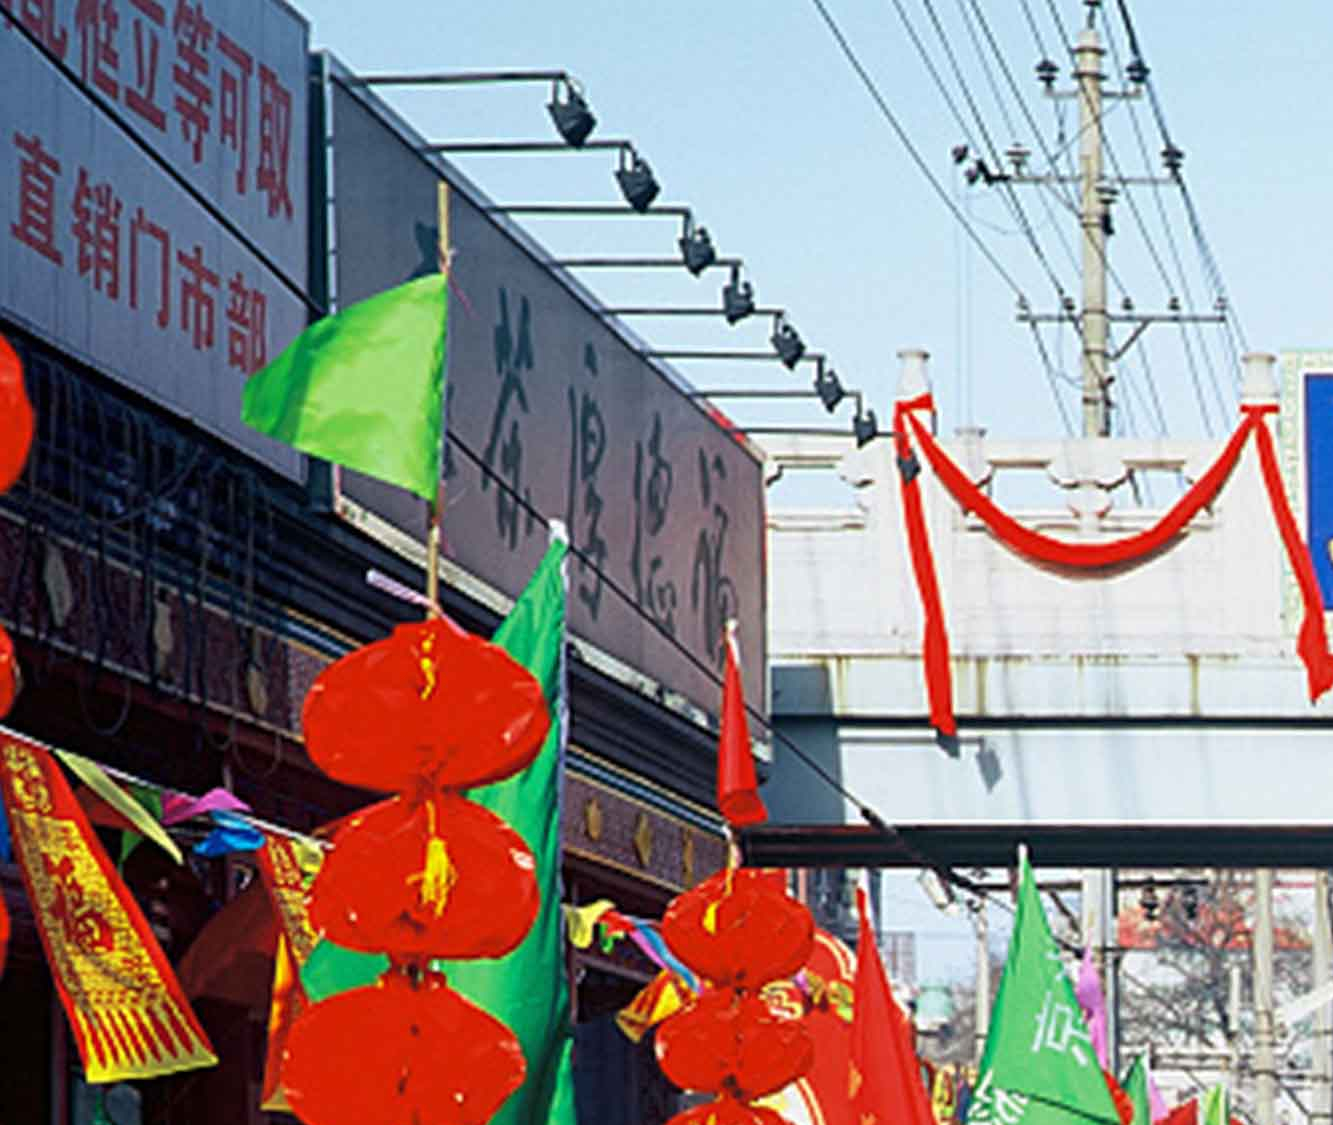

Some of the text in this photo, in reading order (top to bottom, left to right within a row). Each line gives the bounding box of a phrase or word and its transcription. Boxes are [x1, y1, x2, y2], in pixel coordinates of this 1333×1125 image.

[11, 131, 269, 376] 直销门市部
